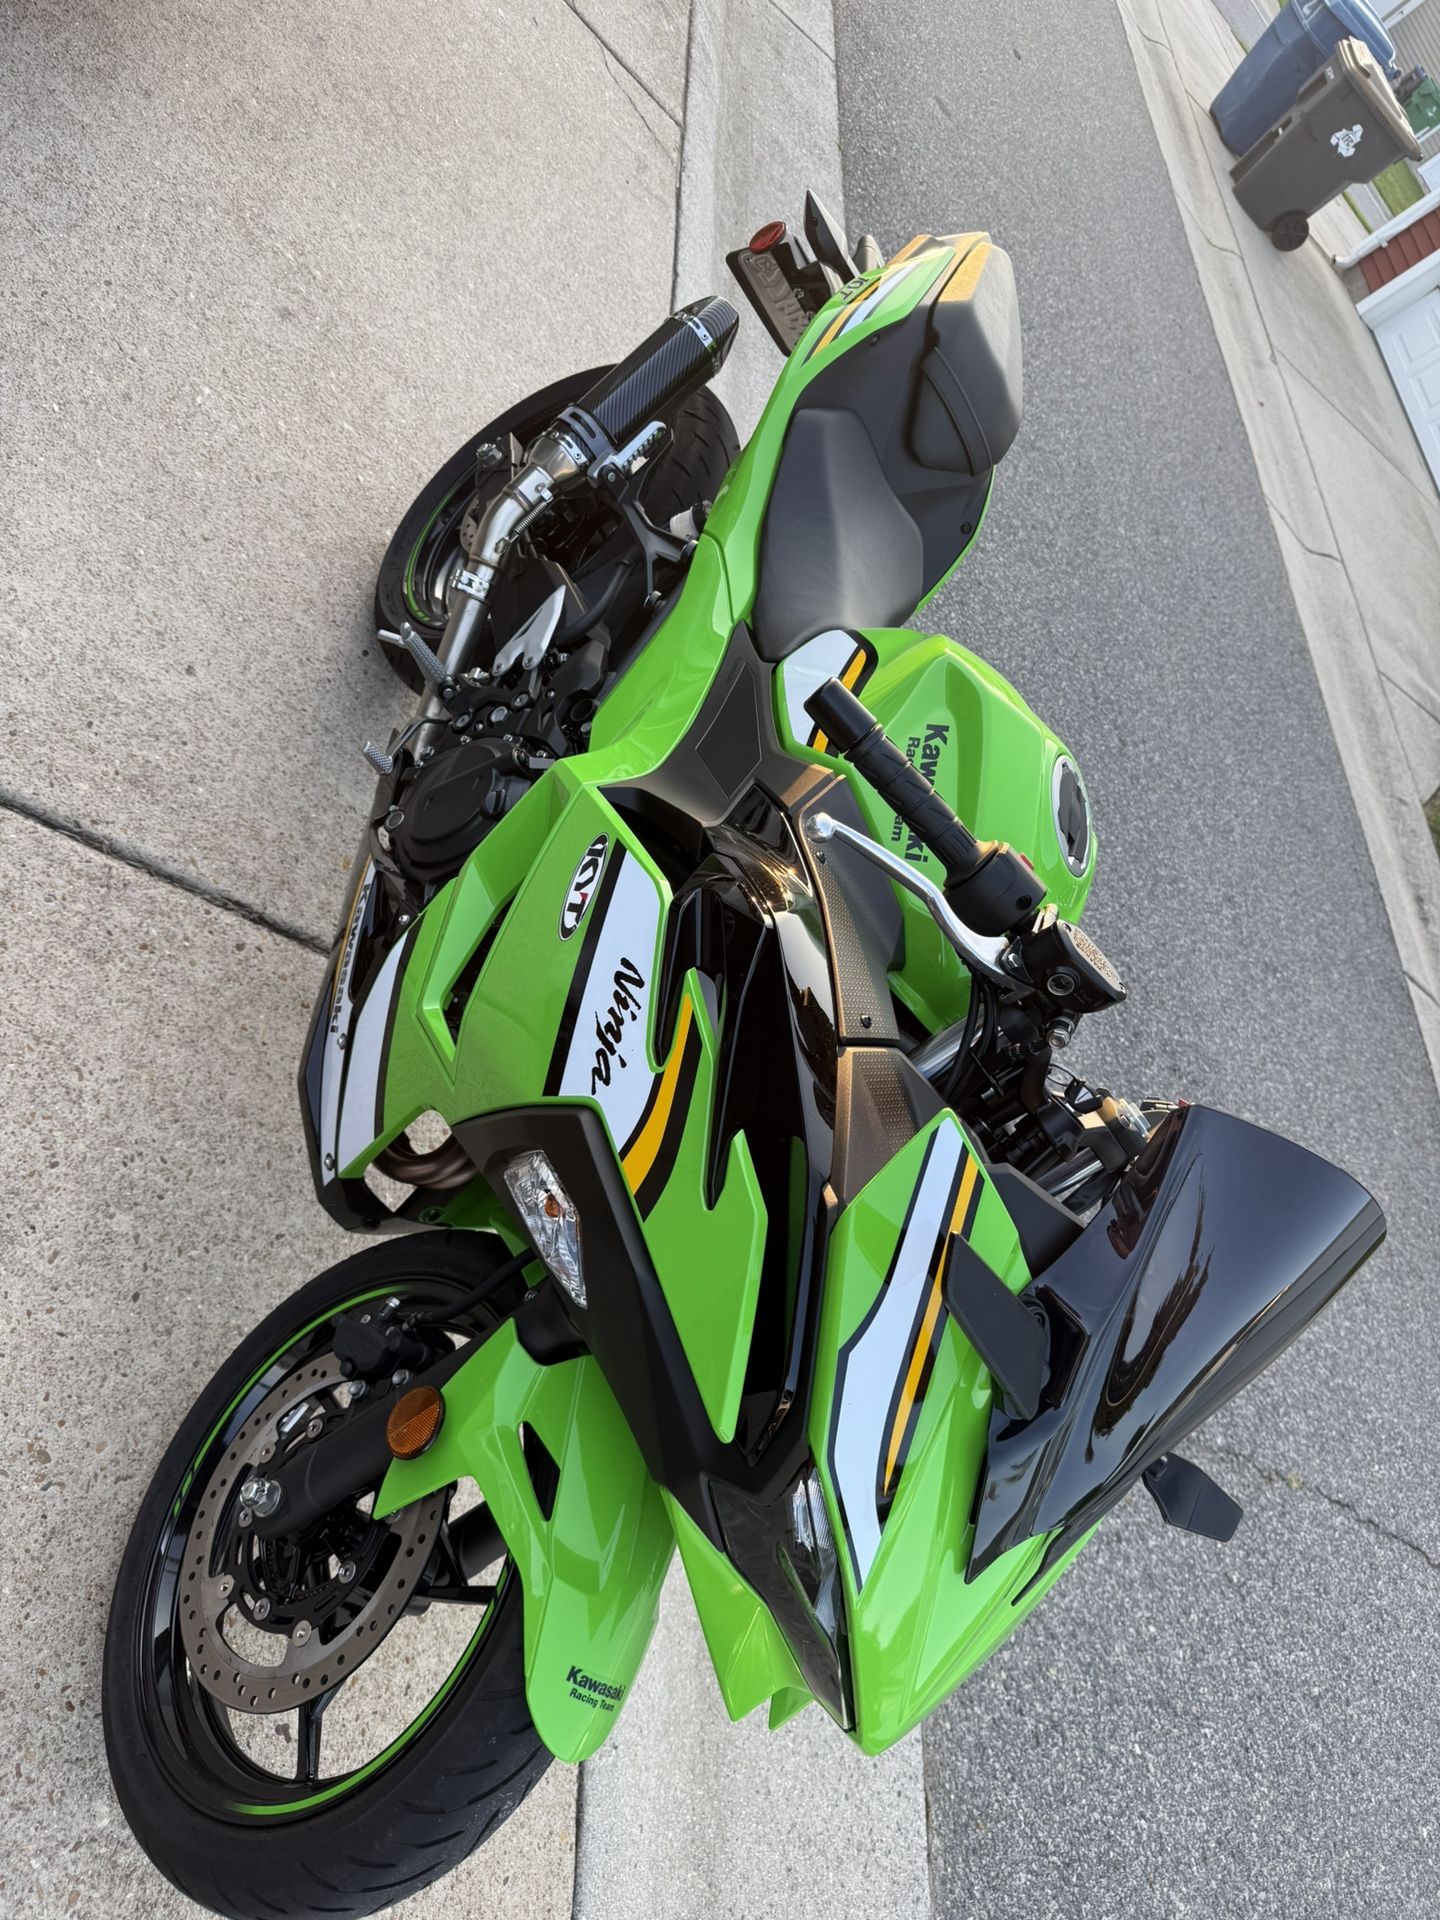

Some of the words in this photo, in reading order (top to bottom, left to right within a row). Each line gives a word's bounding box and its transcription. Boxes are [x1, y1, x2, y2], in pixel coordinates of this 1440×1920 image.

[904, 723, 950, 863] Kawki
[565, 840, 607, 928] KYT
[330, 883, 371, 1034] Kawasaki
[591, 957, 645, 1096] Ninja
[566, 1664, 626, 1701] Kawasaki
[569, 1688, 599, 1709] Racing
